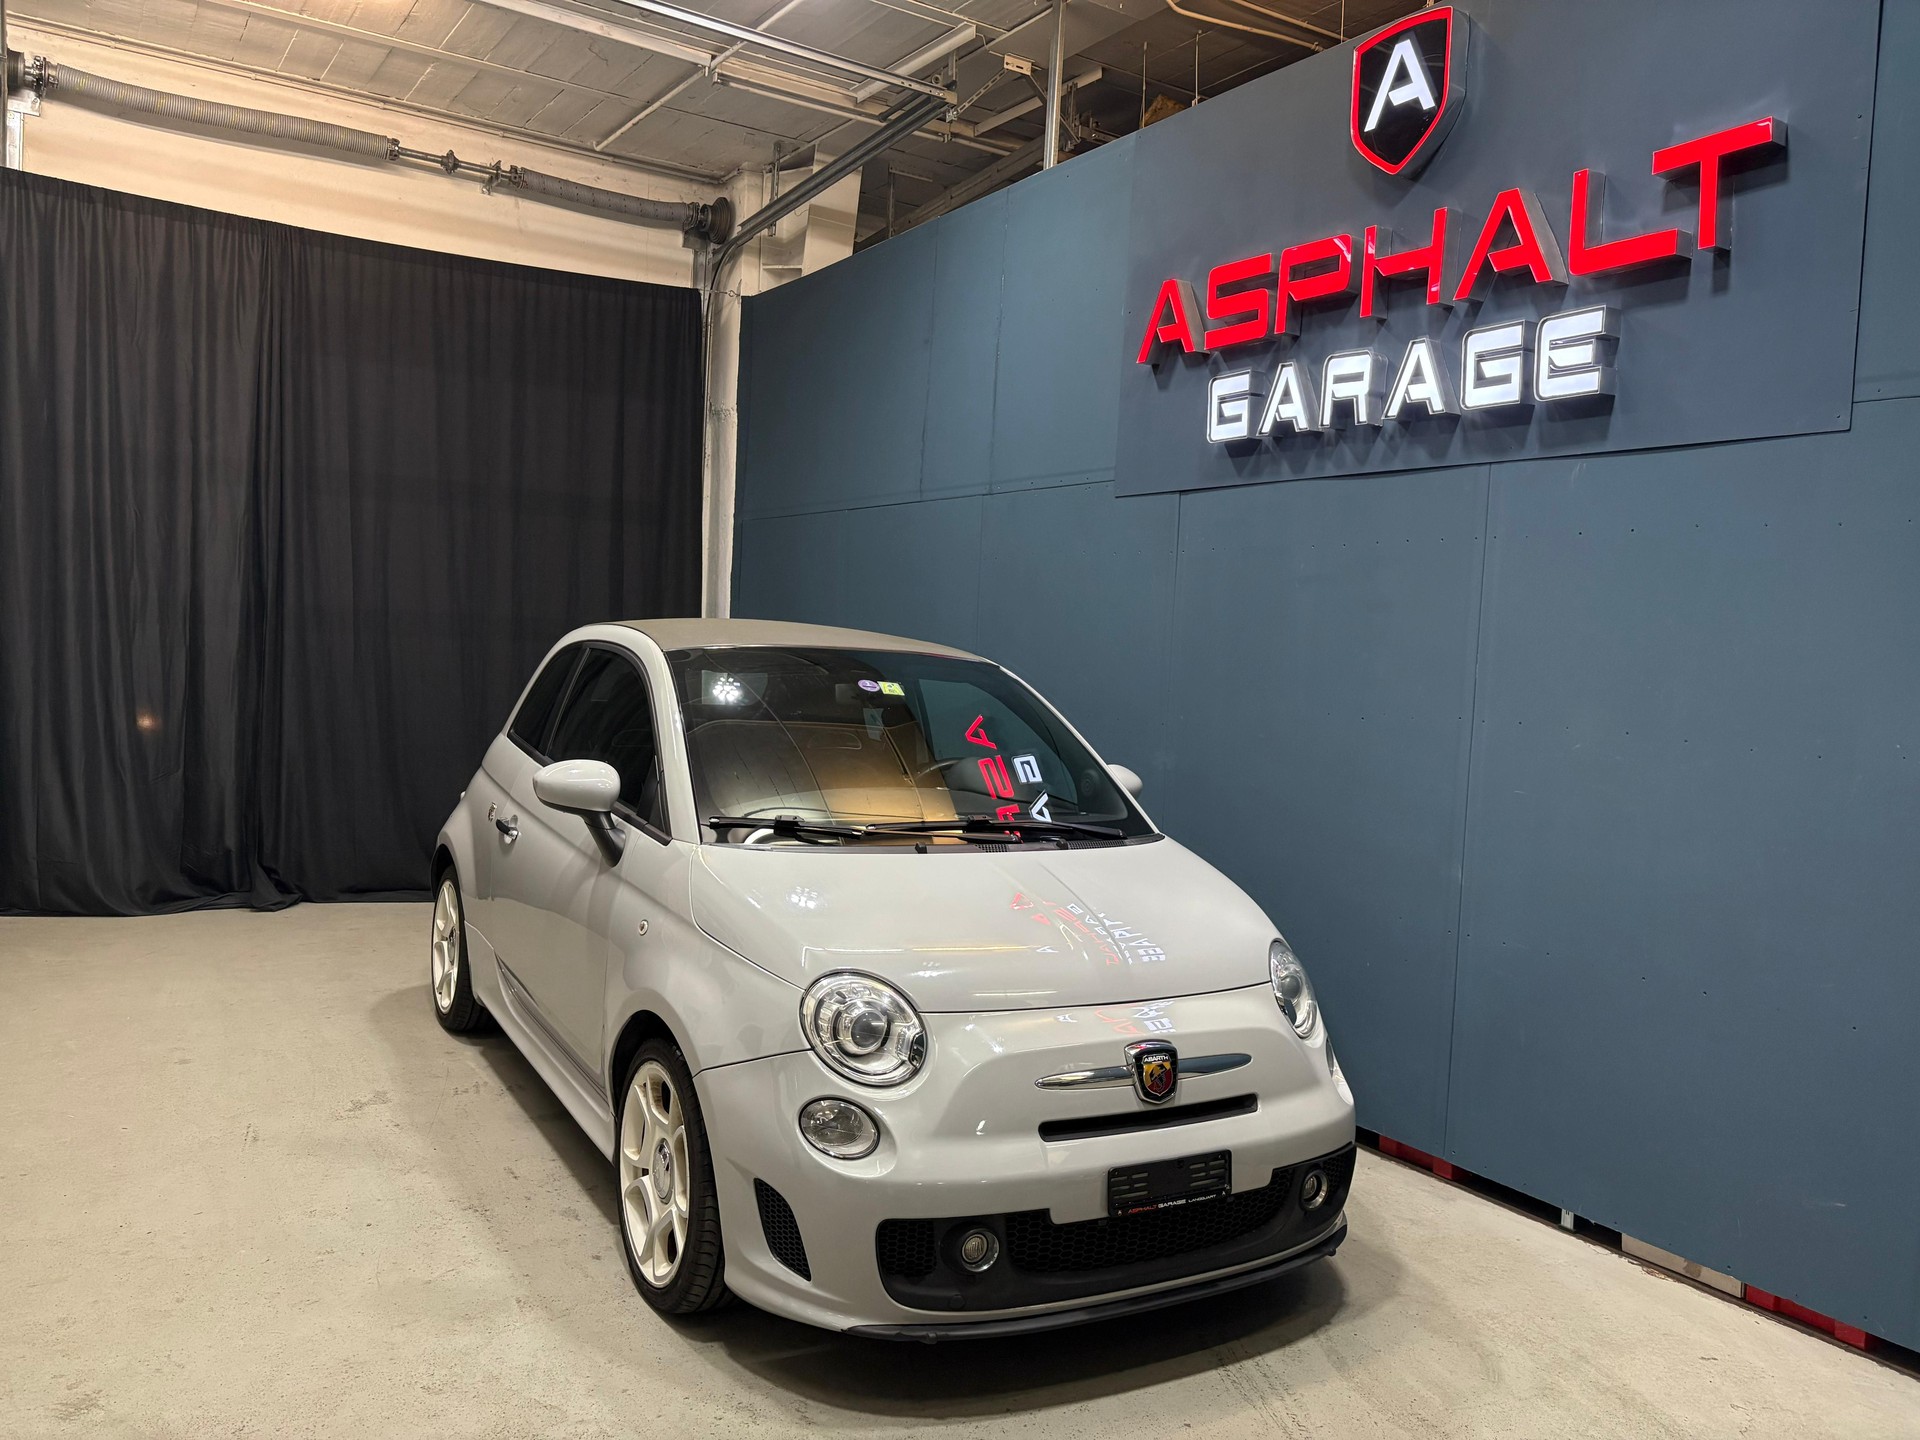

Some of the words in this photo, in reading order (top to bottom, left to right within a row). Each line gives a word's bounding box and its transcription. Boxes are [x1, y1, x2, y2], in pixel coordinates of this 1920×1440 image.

[1364, 38, 1437, 133] A
[1136, 116, 1775, 365] ASPHALT
[1207, 305, 1608, 444] GARAGE
[1158, 1199, 1187, 1210] GARAGE
